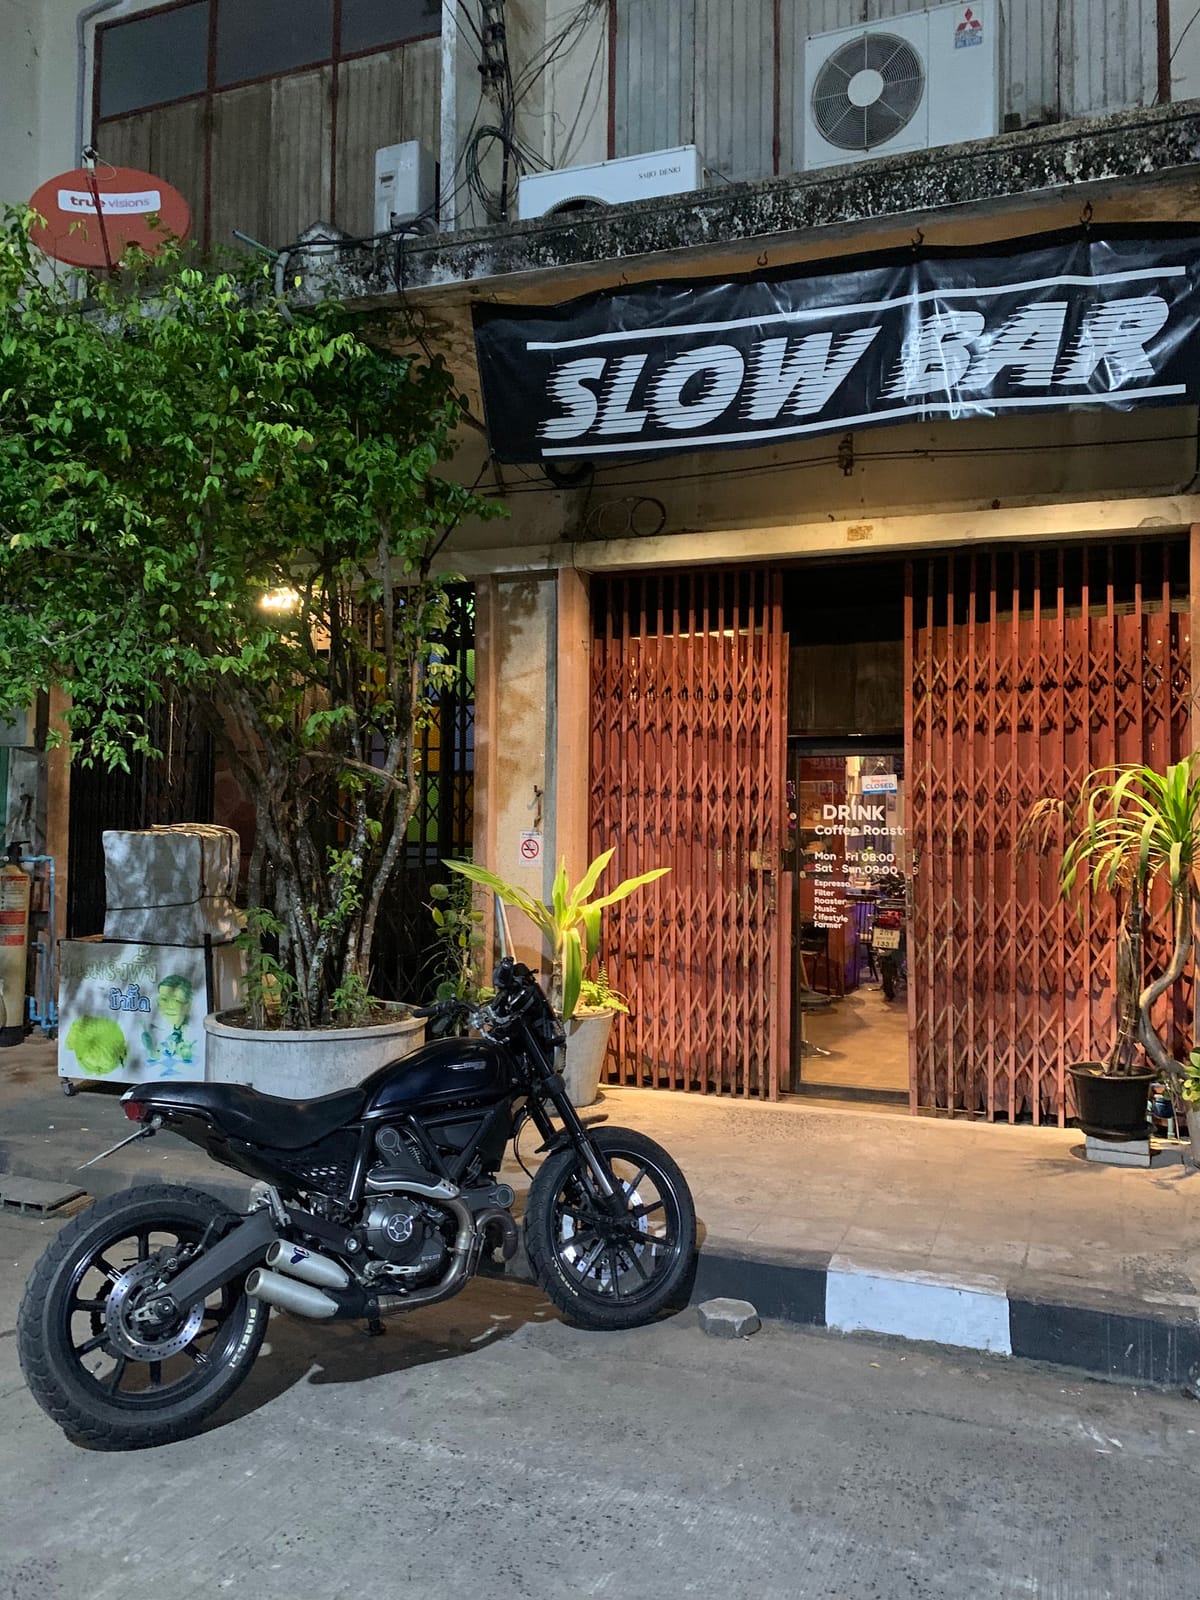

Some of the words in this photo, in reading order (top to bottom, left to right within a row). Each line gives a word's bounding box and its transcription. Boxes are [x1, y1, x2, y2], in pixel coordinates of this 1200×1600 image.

[108, 197, 150, 208] visions
[536, 325, 882, 440] SLOW
[877, 295, 1170, 400] BAR
[823, 804, 886, 821] DRINK
[814, 824, 860, 836] Coffee
[814, 851, 837, 860] Mon
[845, 852, 859, 861] Fri
[861, 853, 895, 862] 08:00
[814, 863, 834, 873] Sat
[864, 865, 898, 875] 09:00
[814, 879, 851, 888] Espresso
[814, 889, 835, 897] Filter
[814, 897, 847, 905] Roaster
[814, 905, 837, 913] Music
[814, 921, 842, 929] Farmer
[228, 1308, 257, 1368] PIRELLI
